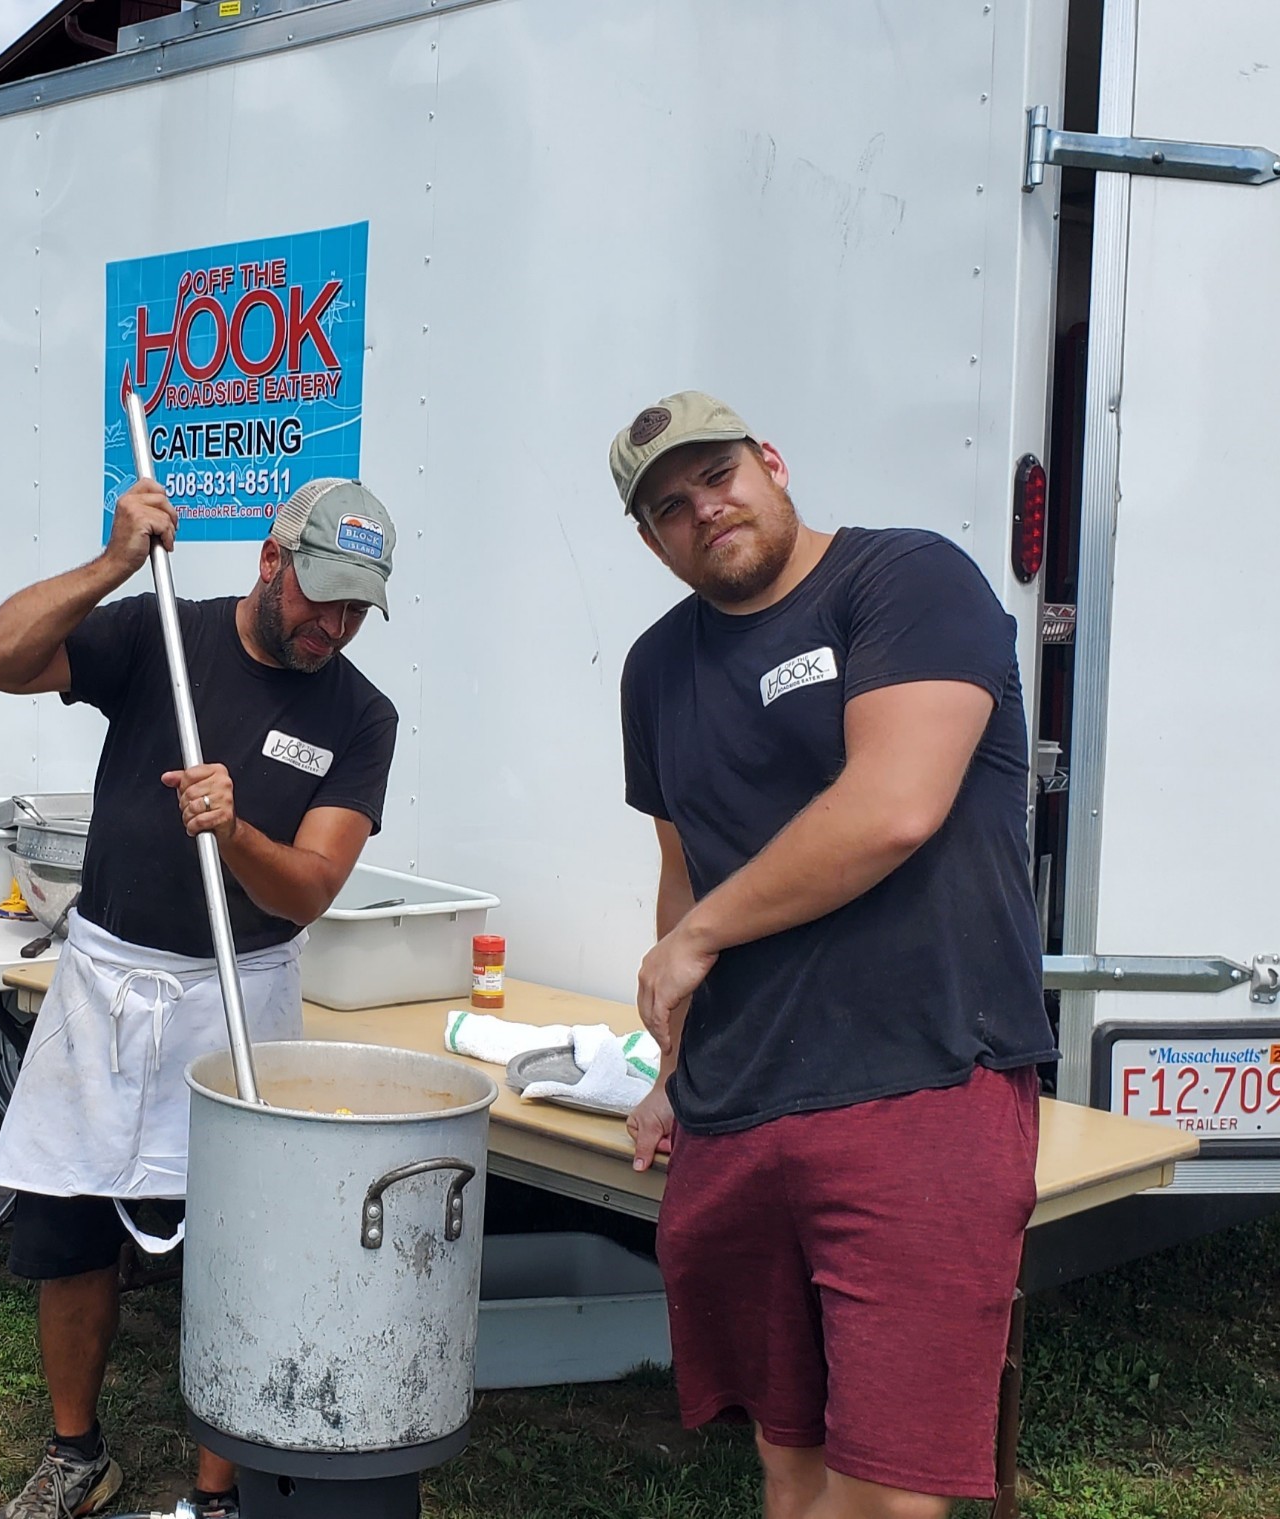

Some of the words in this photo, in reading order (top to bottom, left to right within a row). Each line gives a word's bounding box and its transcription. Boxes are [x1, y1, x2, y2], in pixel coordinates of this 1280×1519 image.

[192, 265, 234, 296] OFF
[239, 258, 286, 290] THE
[121, 273, 342, 414] HOOK
[165, 376, 263, 409] ROADSIDE
[264, 371, 341, 401] EATERY
[150, 417, 303, 461] CATERING
[165, 468, 291, 497] 508-831-8511
[346, 529, 379, 545] BLOCK
[767, 657, 824, 700] HOOK
[271, 739, 324, 769] HOOK
[1157, 1047, 1262, 1064] Massachusetts
[1176, 1118, 1238, 1131] TRAILER
